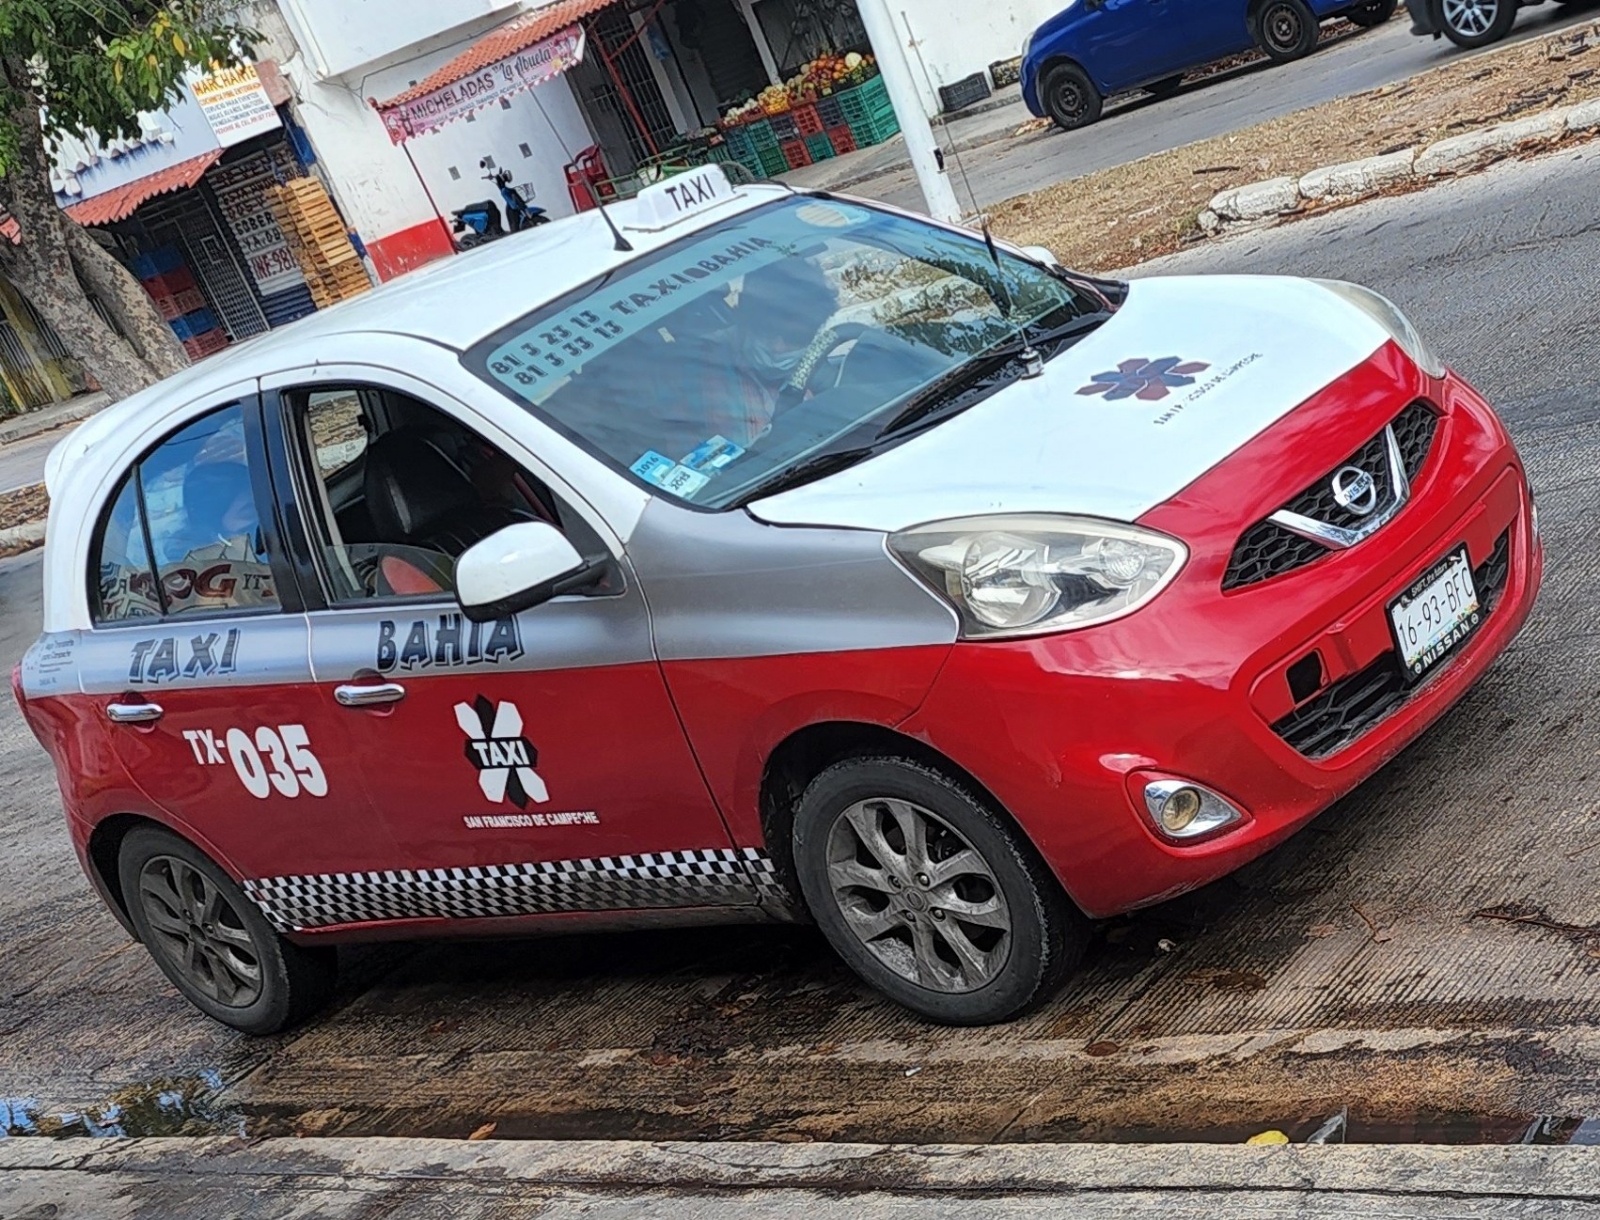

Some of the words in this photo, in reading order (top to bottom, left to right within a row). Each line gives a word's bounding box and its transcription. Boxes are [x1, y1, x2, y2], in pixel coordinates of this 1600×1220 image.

[410, 73, 495, 120] MICHELADAS
[664, 173, 716, 211] TAXI
[609, 272, 692, 317] TAXI
[697, 237, 776, 272] BAHIA
[490, 354, 523, 376] 81
[520, 341, 542, 360] 3
[539, 323, 572, 347] 23
[569, 309, 601, 331] 13
[514, 363, 549, 387] 81
[545, 350, 565, 368] 3
[562, 335, 595, 359] 33
[593, 318, 624, 342] 13
[636, 456, 659, 475] 2016
[1398, 566, 1474, 653] 16-93-BFC
[128, 627, 241, 684] TAXI
[377, 613, 525, 673] BAHIA
[1422, 620, 1470, 669] NISSAN
[182, 724, 328, 799] TX-035
[472, 740, 530, 767] TAXI
[463, 815, 484, 829] SAN
[482, 814, 533, 829] FRANCISCO
[531, 813, 549, 827] DE
[546, 811, 600, 827] CAMPECHE
